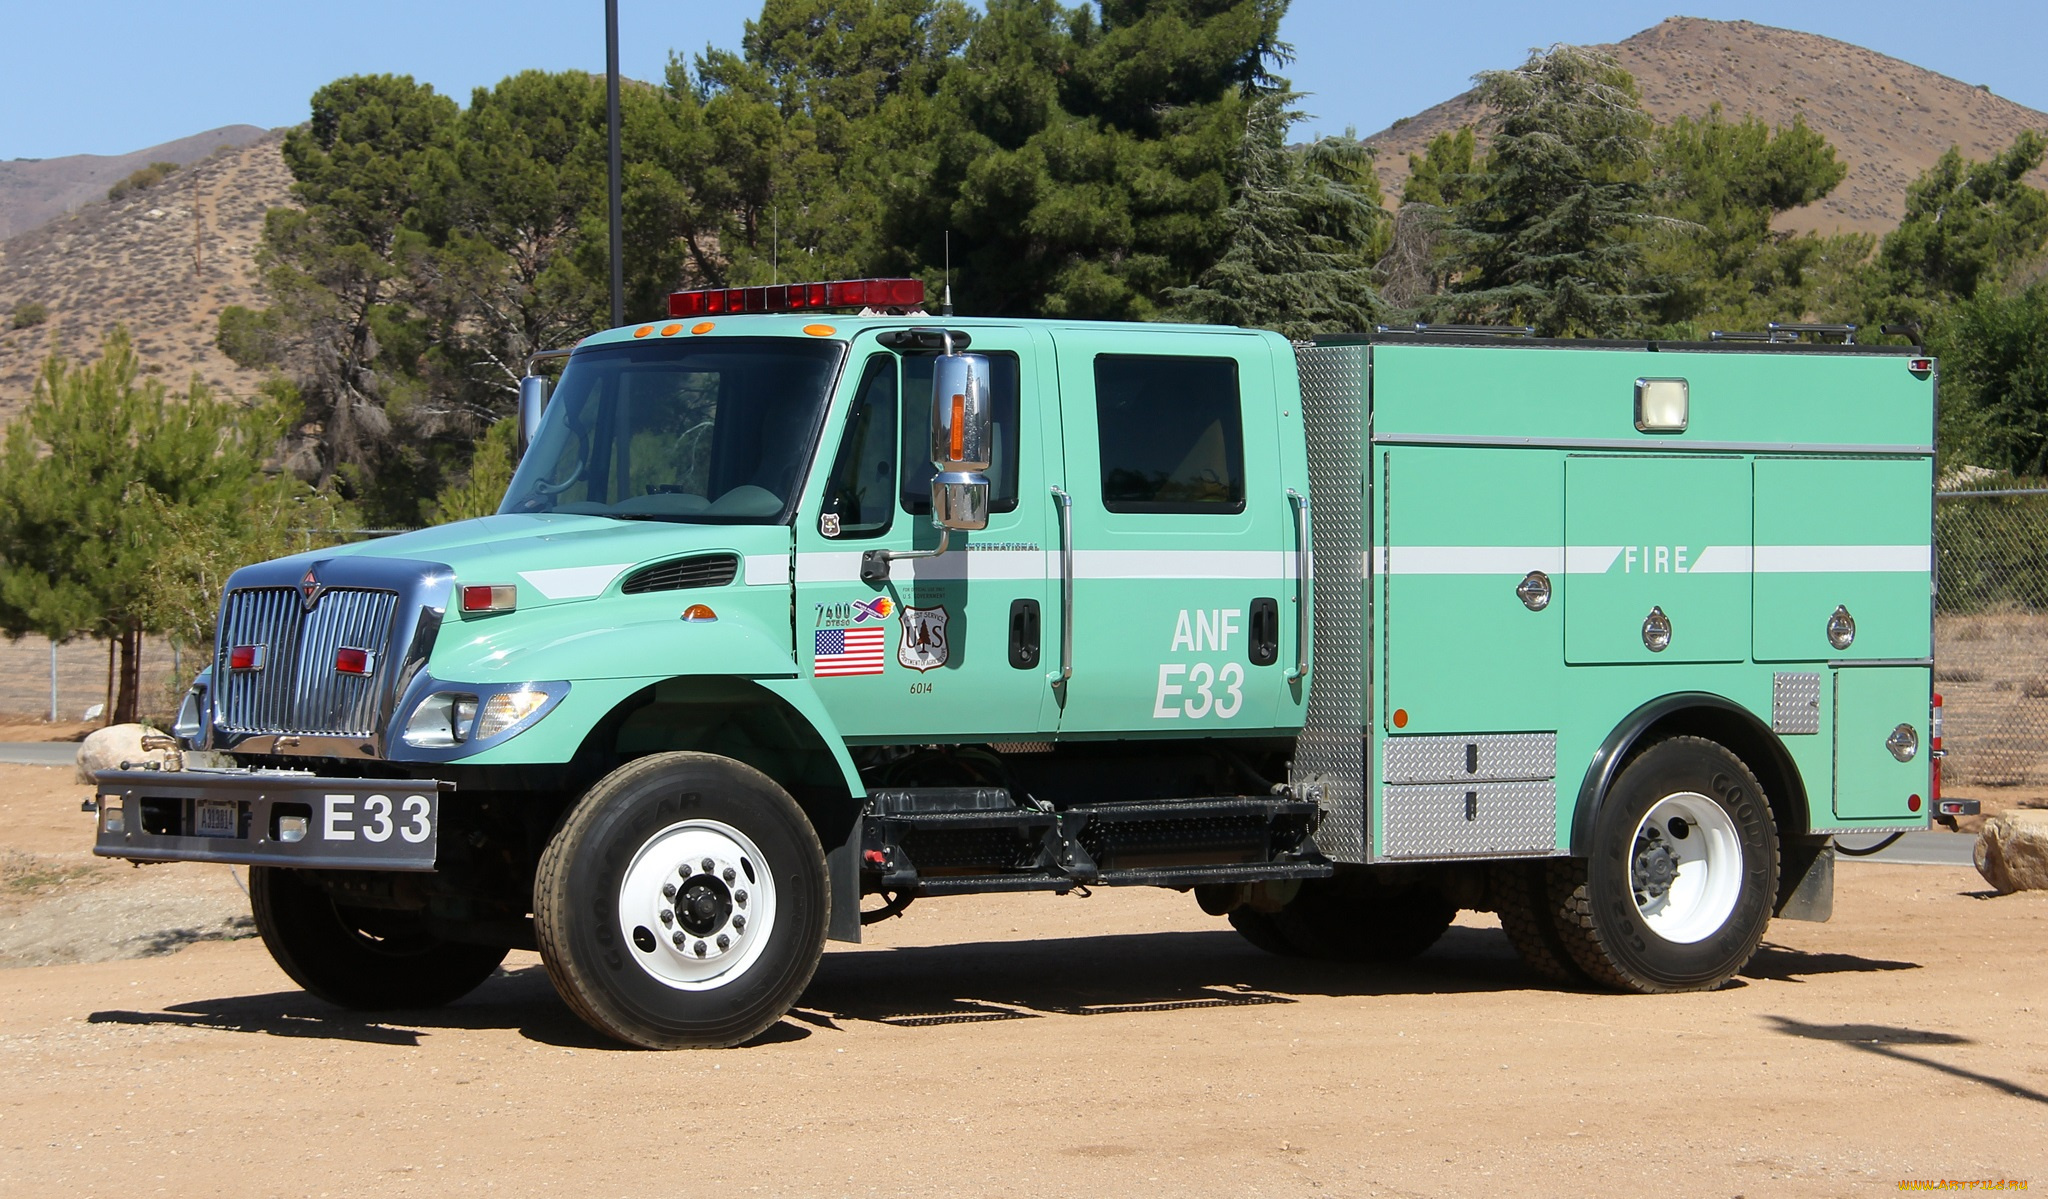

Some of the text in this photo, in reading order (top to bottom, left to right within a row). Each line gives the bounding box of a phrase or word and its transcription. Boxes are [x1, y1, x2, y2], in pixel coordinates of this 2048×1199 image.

[965, 542, 1040, 551] INTERNATIONAL
[1624, 545, 1688, 574] FIRE
[815, 602, 850, 627] 7400
[924, 611, 944, 624] SERVICE
[1170, 608, 1241, 652] ANF
[910, 682, 932, 695] 6014
[1152, 662, 1245, 719] E33
[323, 794, 432, 844] E33
